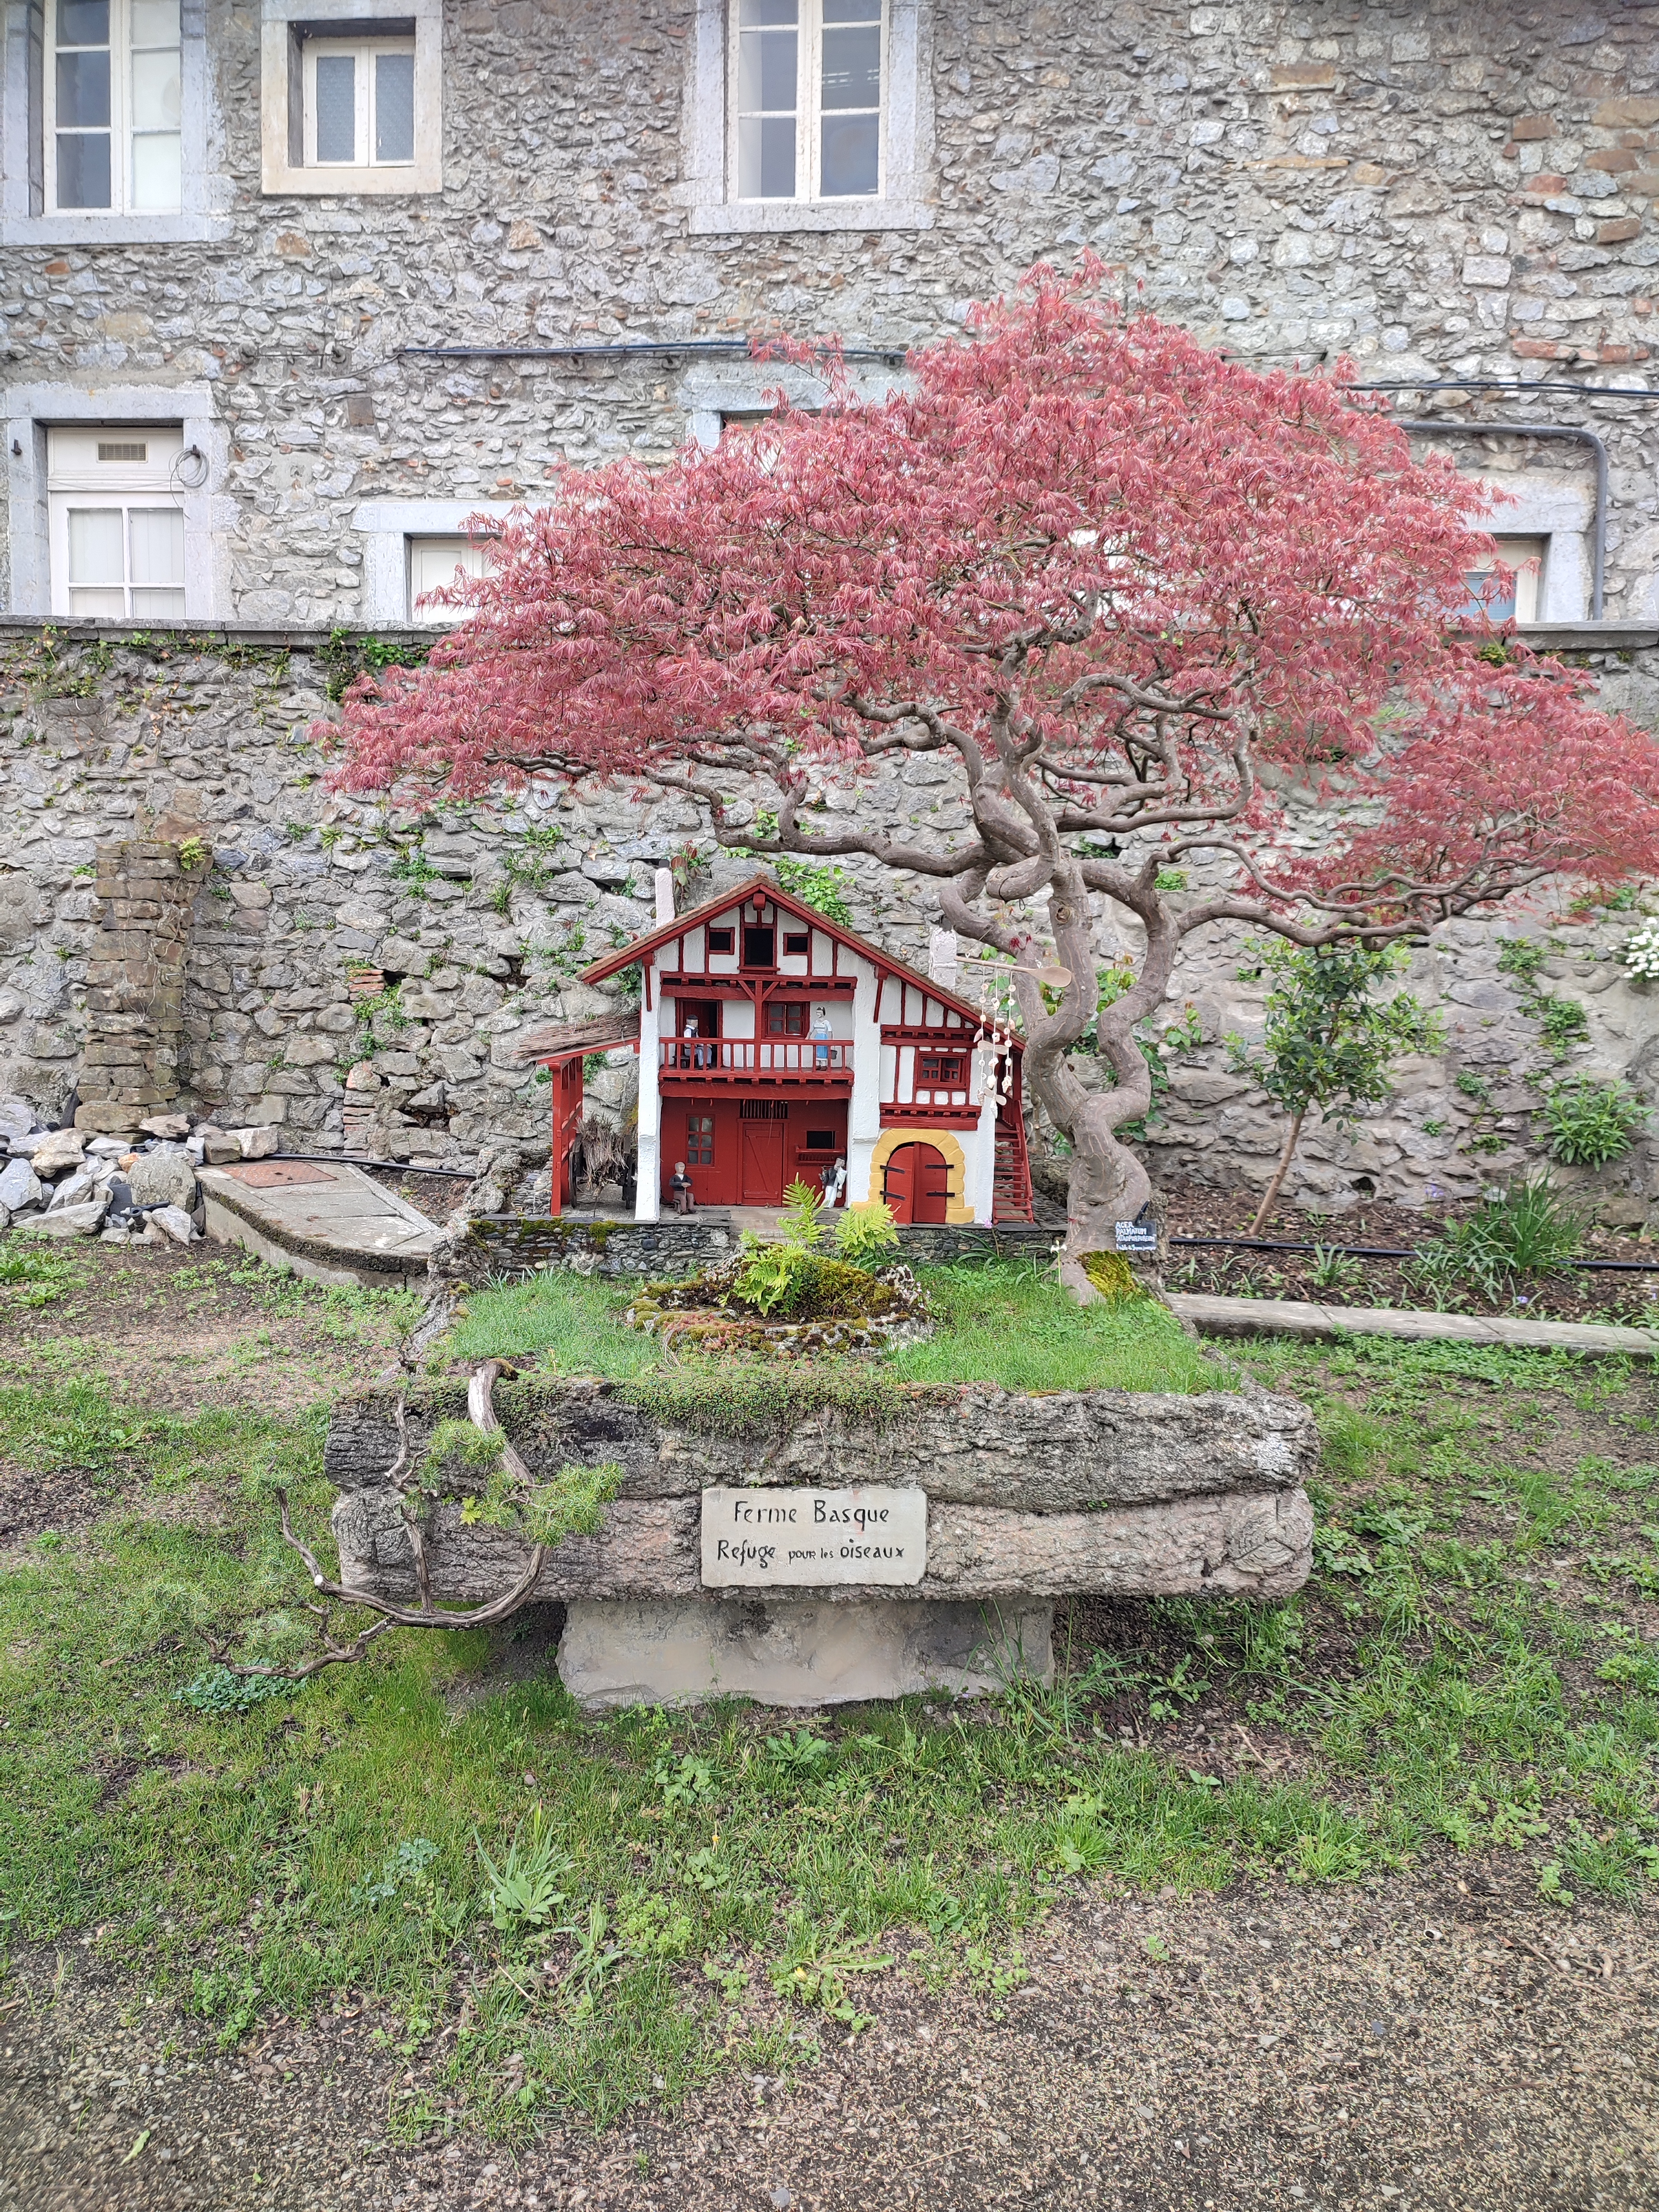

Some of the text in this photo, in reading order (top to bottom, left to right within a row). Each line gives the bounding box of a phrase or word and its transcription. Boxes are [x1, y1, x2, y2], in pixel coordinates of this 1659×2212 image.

[734, 1499, 889, 1531] Ferme Basque
[717, 1540, 776, 1569] Refuge
[821, 1548, 833, 1559] les
[840, 1538, 905, 1559] oiseaux
